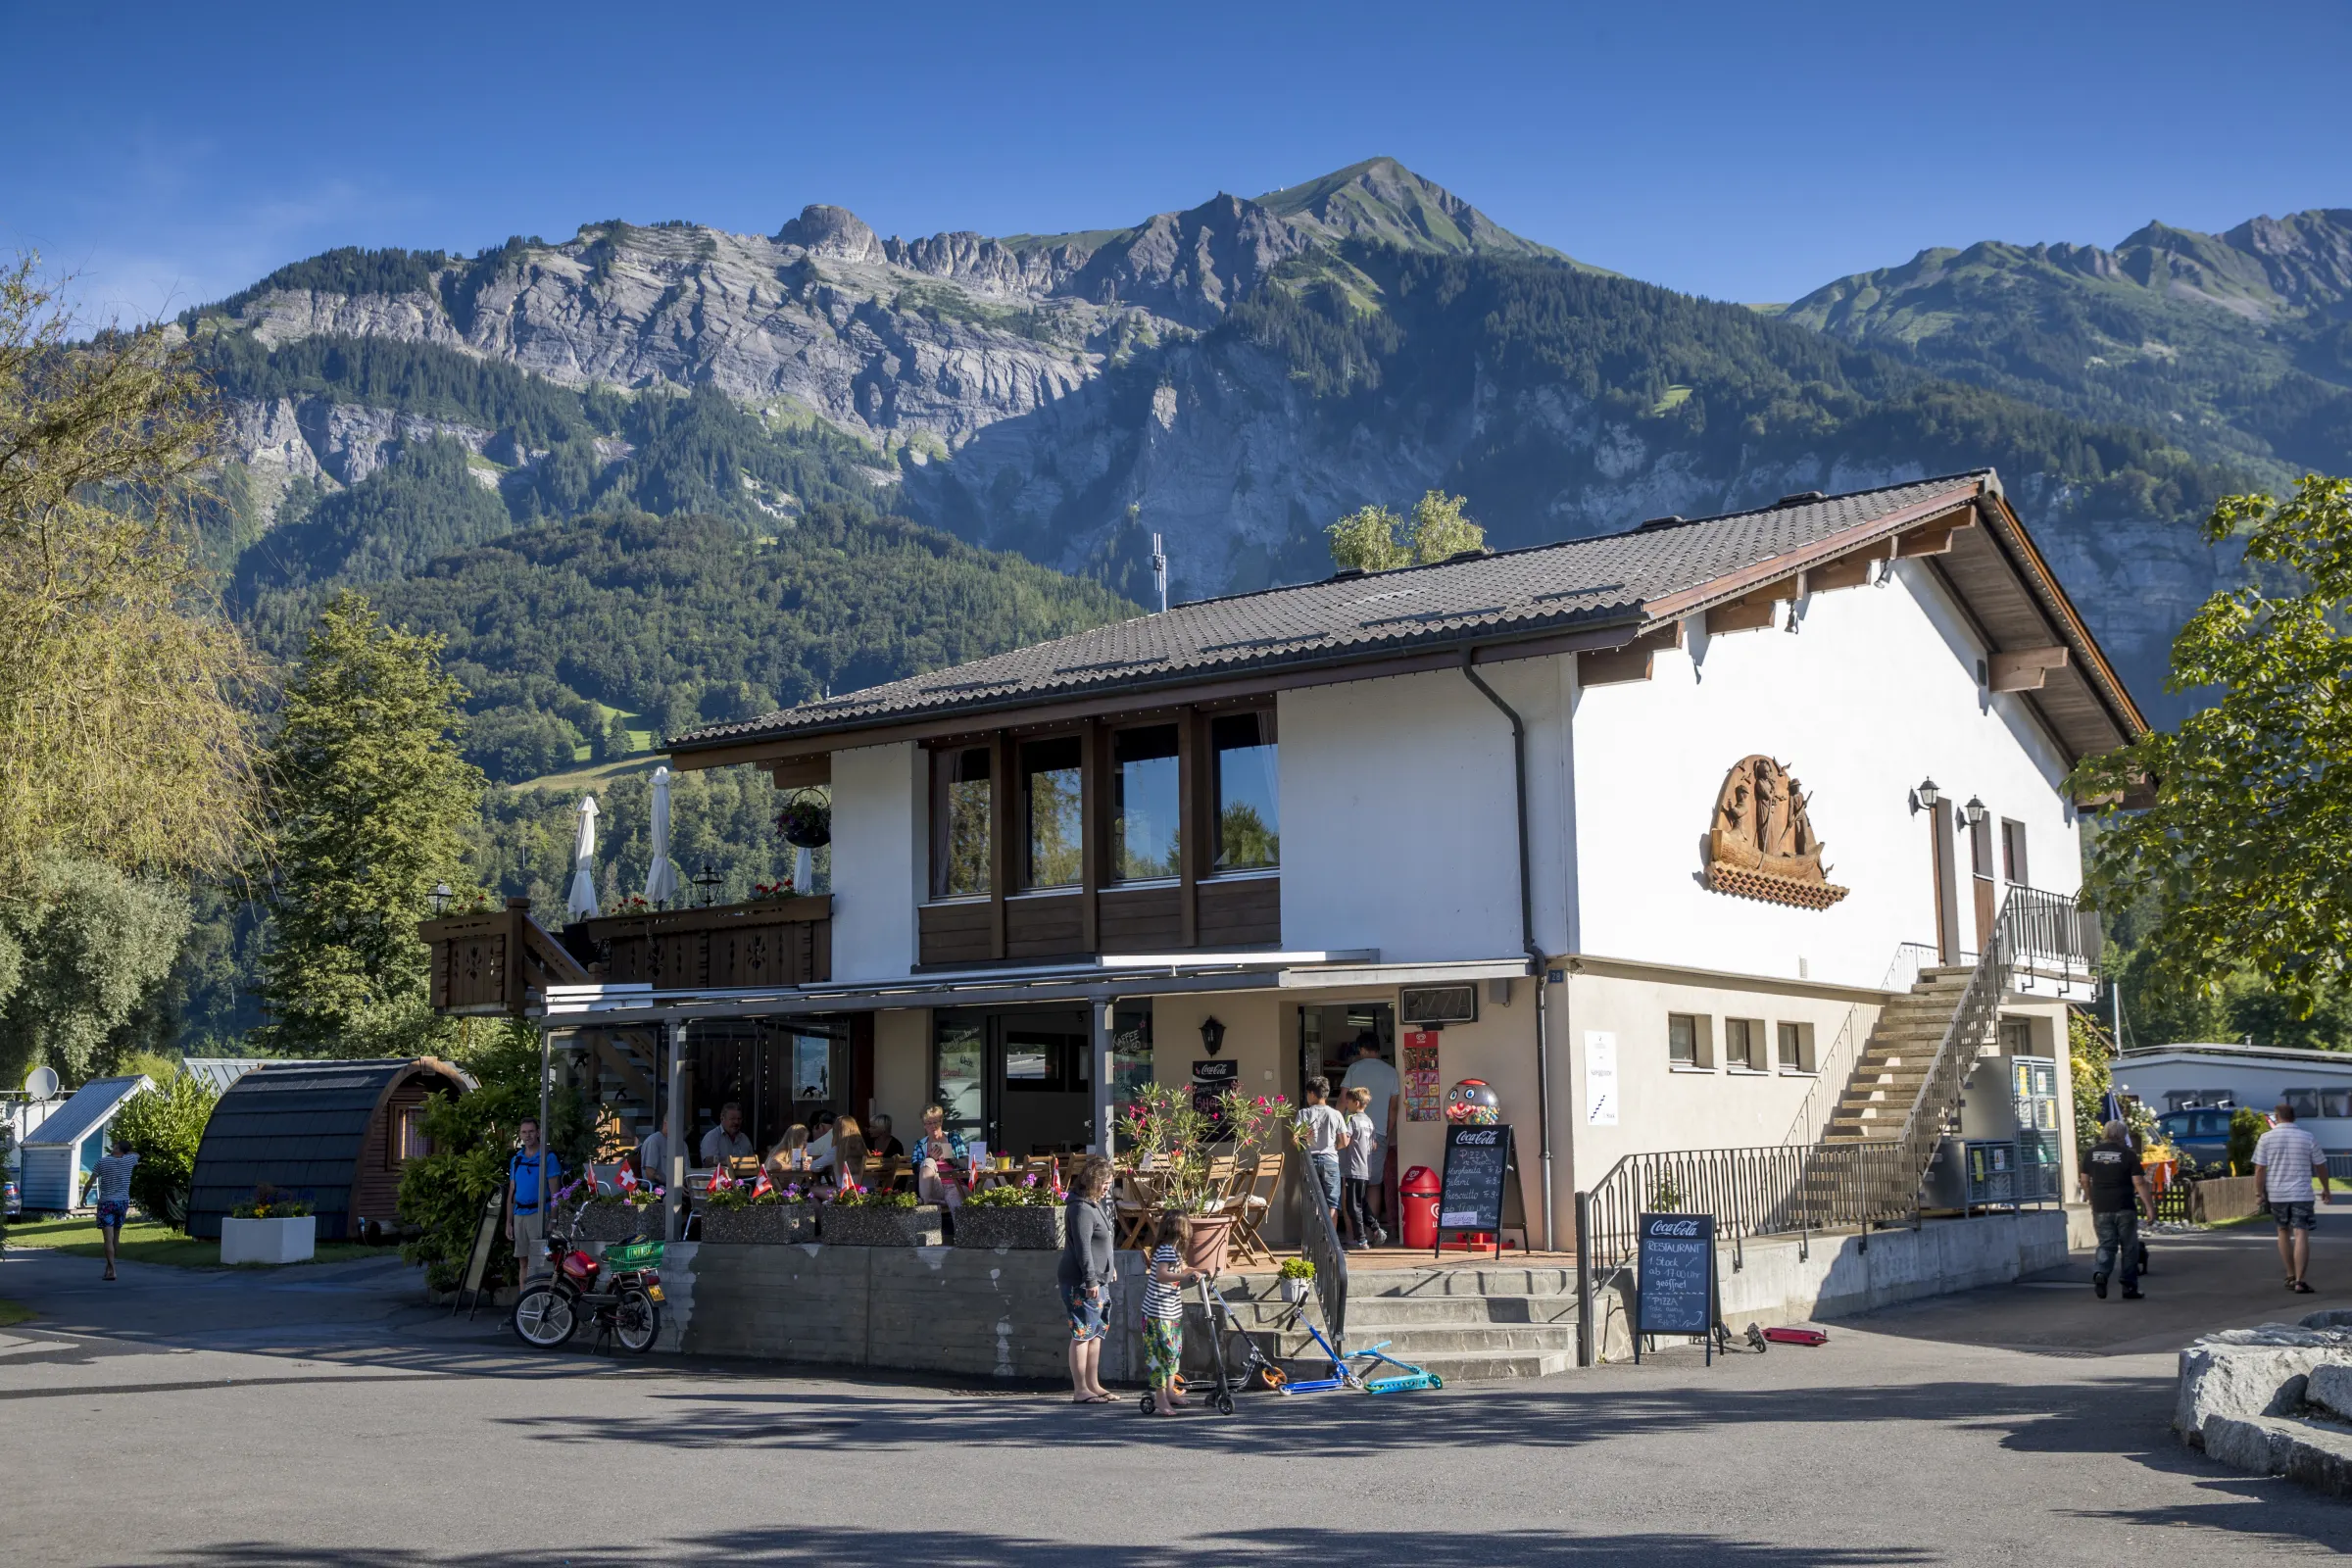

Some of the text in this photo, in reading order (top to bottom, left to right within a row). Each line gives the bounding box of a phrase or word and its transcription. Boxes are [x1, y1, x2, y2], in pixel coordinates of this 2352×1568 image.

[1551, 972, 1561, 981] 28
[1405, 990, 1470, 1018] PIZZA
[1112, 1030, 1140, 1048] KAFFEE
[1131, 1040, 1142, 1052] GO
[1444, 1204, 1455, 1213] ab
[1476, 1203, 1491, 1212] Uhr
[1646, 1240, 1706, 1253] RESTAURANT
[1655, 1255, 1679, 1267] Stock
[1648, 1266, 1661, 1276] ab
[1687, 1269, 1701, 1279] Uhr
[1655, 1278, 1687, 1293] geöffnet
